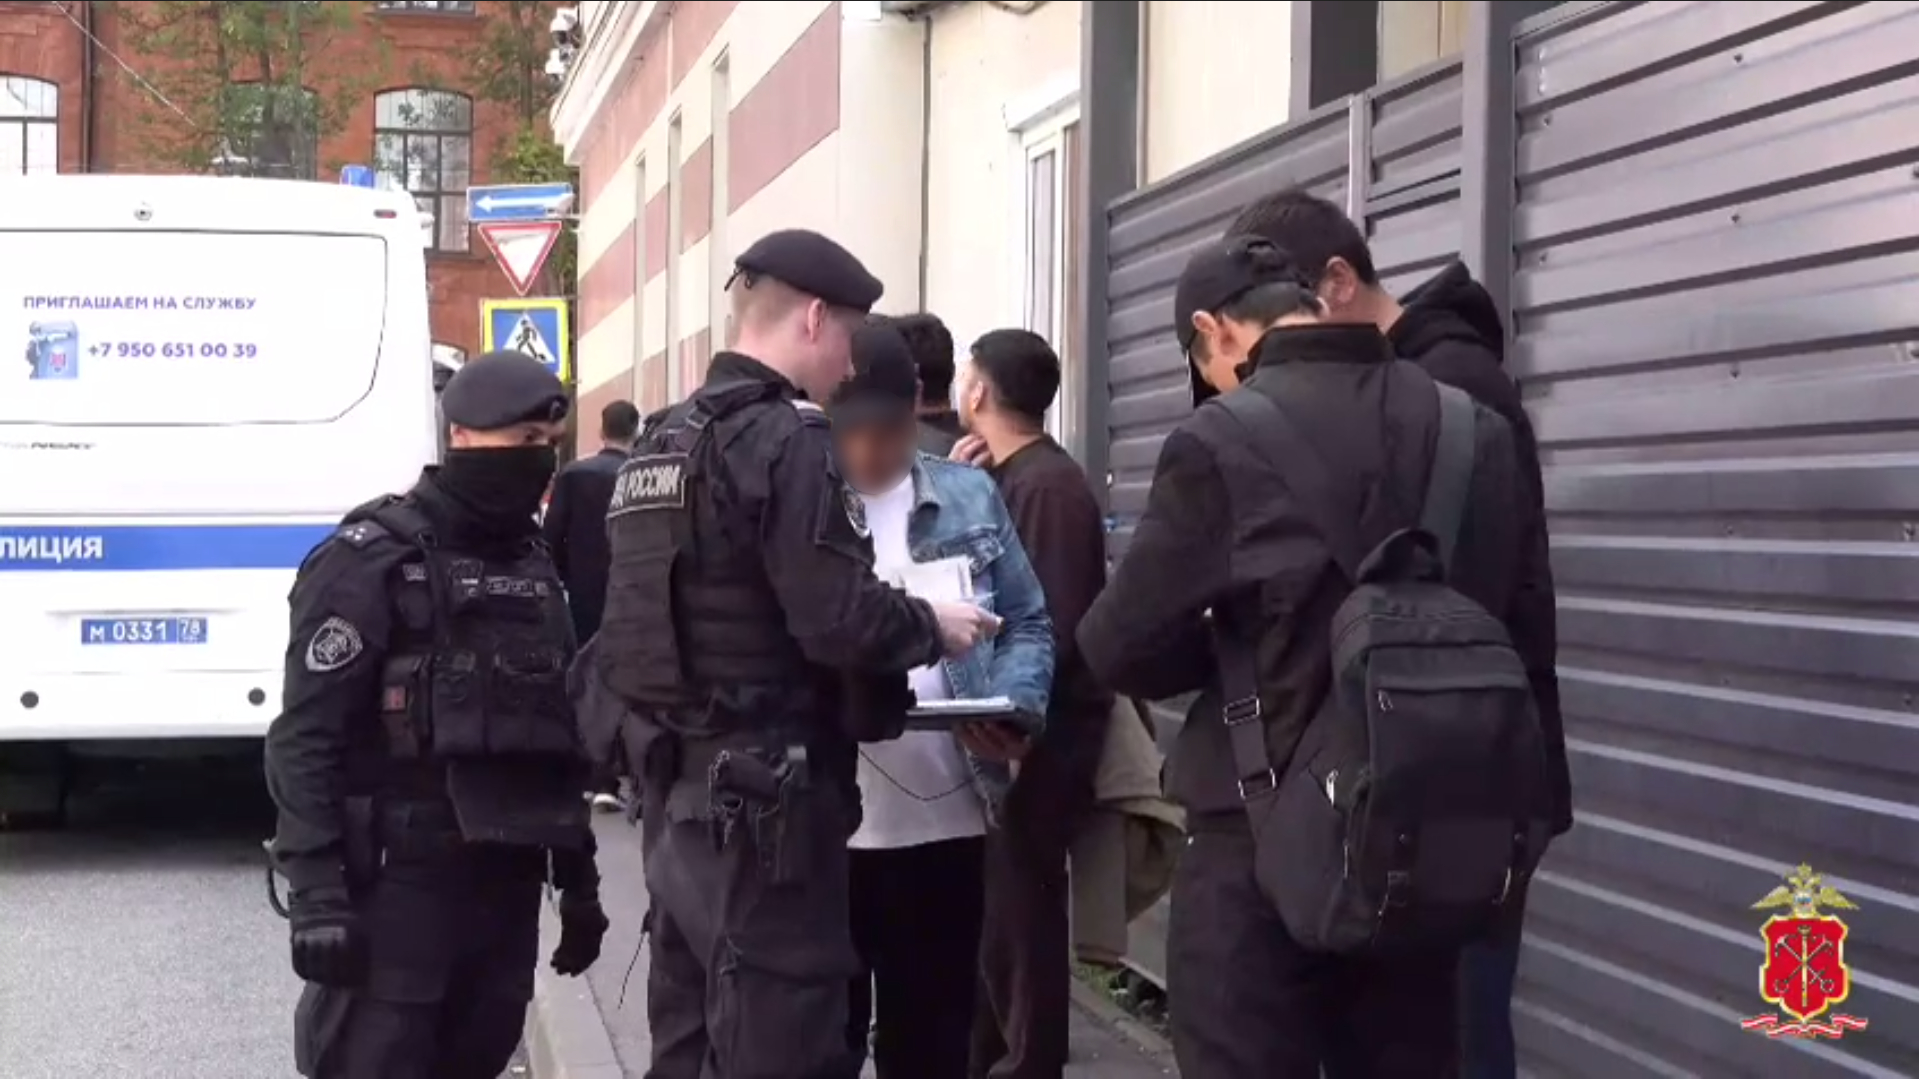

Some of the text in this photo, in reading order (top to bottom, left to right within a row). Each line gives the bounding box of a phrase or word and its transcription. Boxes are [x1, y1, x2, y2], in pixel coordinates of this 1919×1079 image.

[23, 296, 256, 309] ПРИГЛАШАЕМ НА СЛУЖБУ
[88, 342, 258, 358] +7 950 651 00 39
[112, 621, 167, 641] 0331
